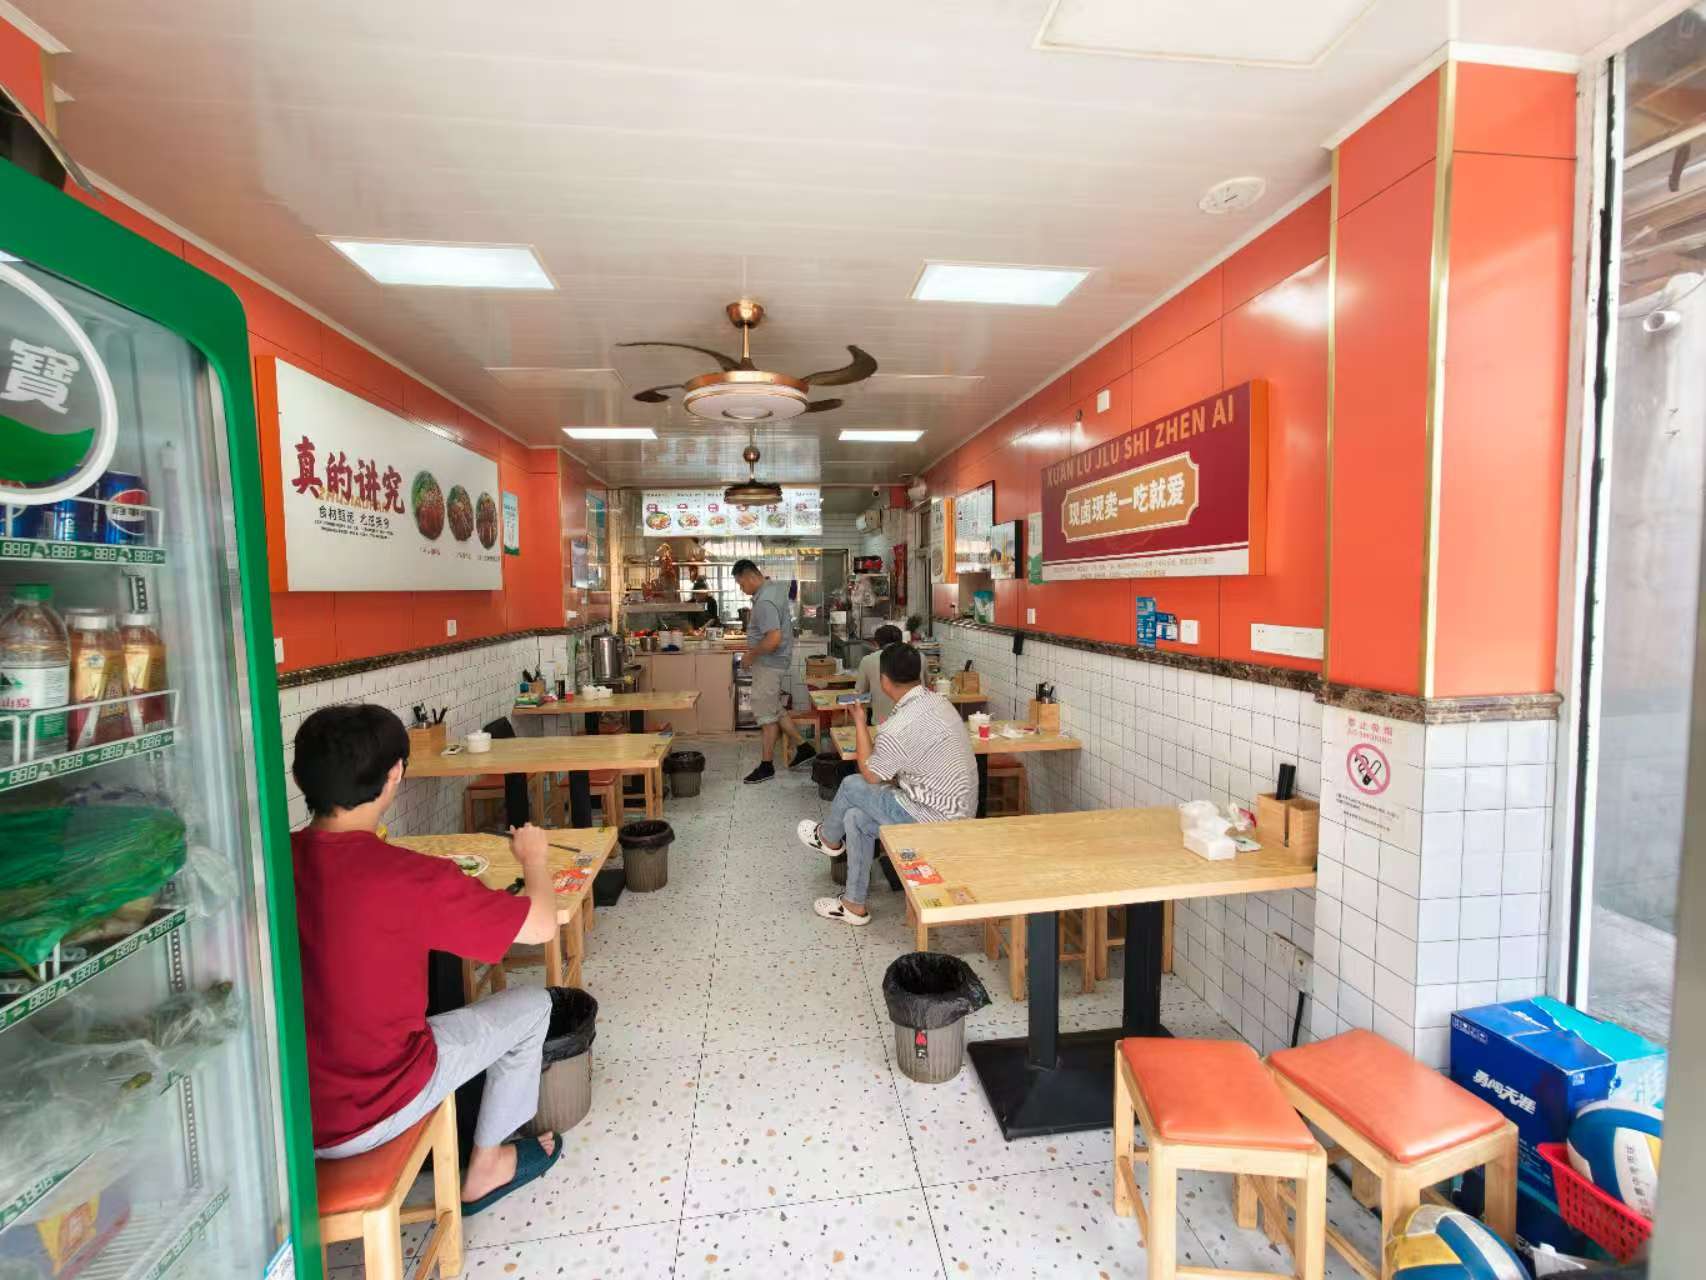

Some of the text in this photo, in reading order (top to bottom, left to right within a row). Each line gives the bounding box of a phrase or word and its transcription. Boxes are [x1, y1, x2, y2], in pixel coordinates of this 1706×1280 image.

[1, 338, 80, 415] 寶
[291, 434, 406, 514] 真的讲究
[1077, 453, 1092, 477] LU
[1124, 428, 1150, 460] SHI
[1154, 405, 1206, 448] ZHEN
[1212, 394, 1235, 429] AI
[1068, 471, 1185, 527] 现卤现卖一吃就爱
[1473, 1069, 1536, 1115] 勇闯天涯
